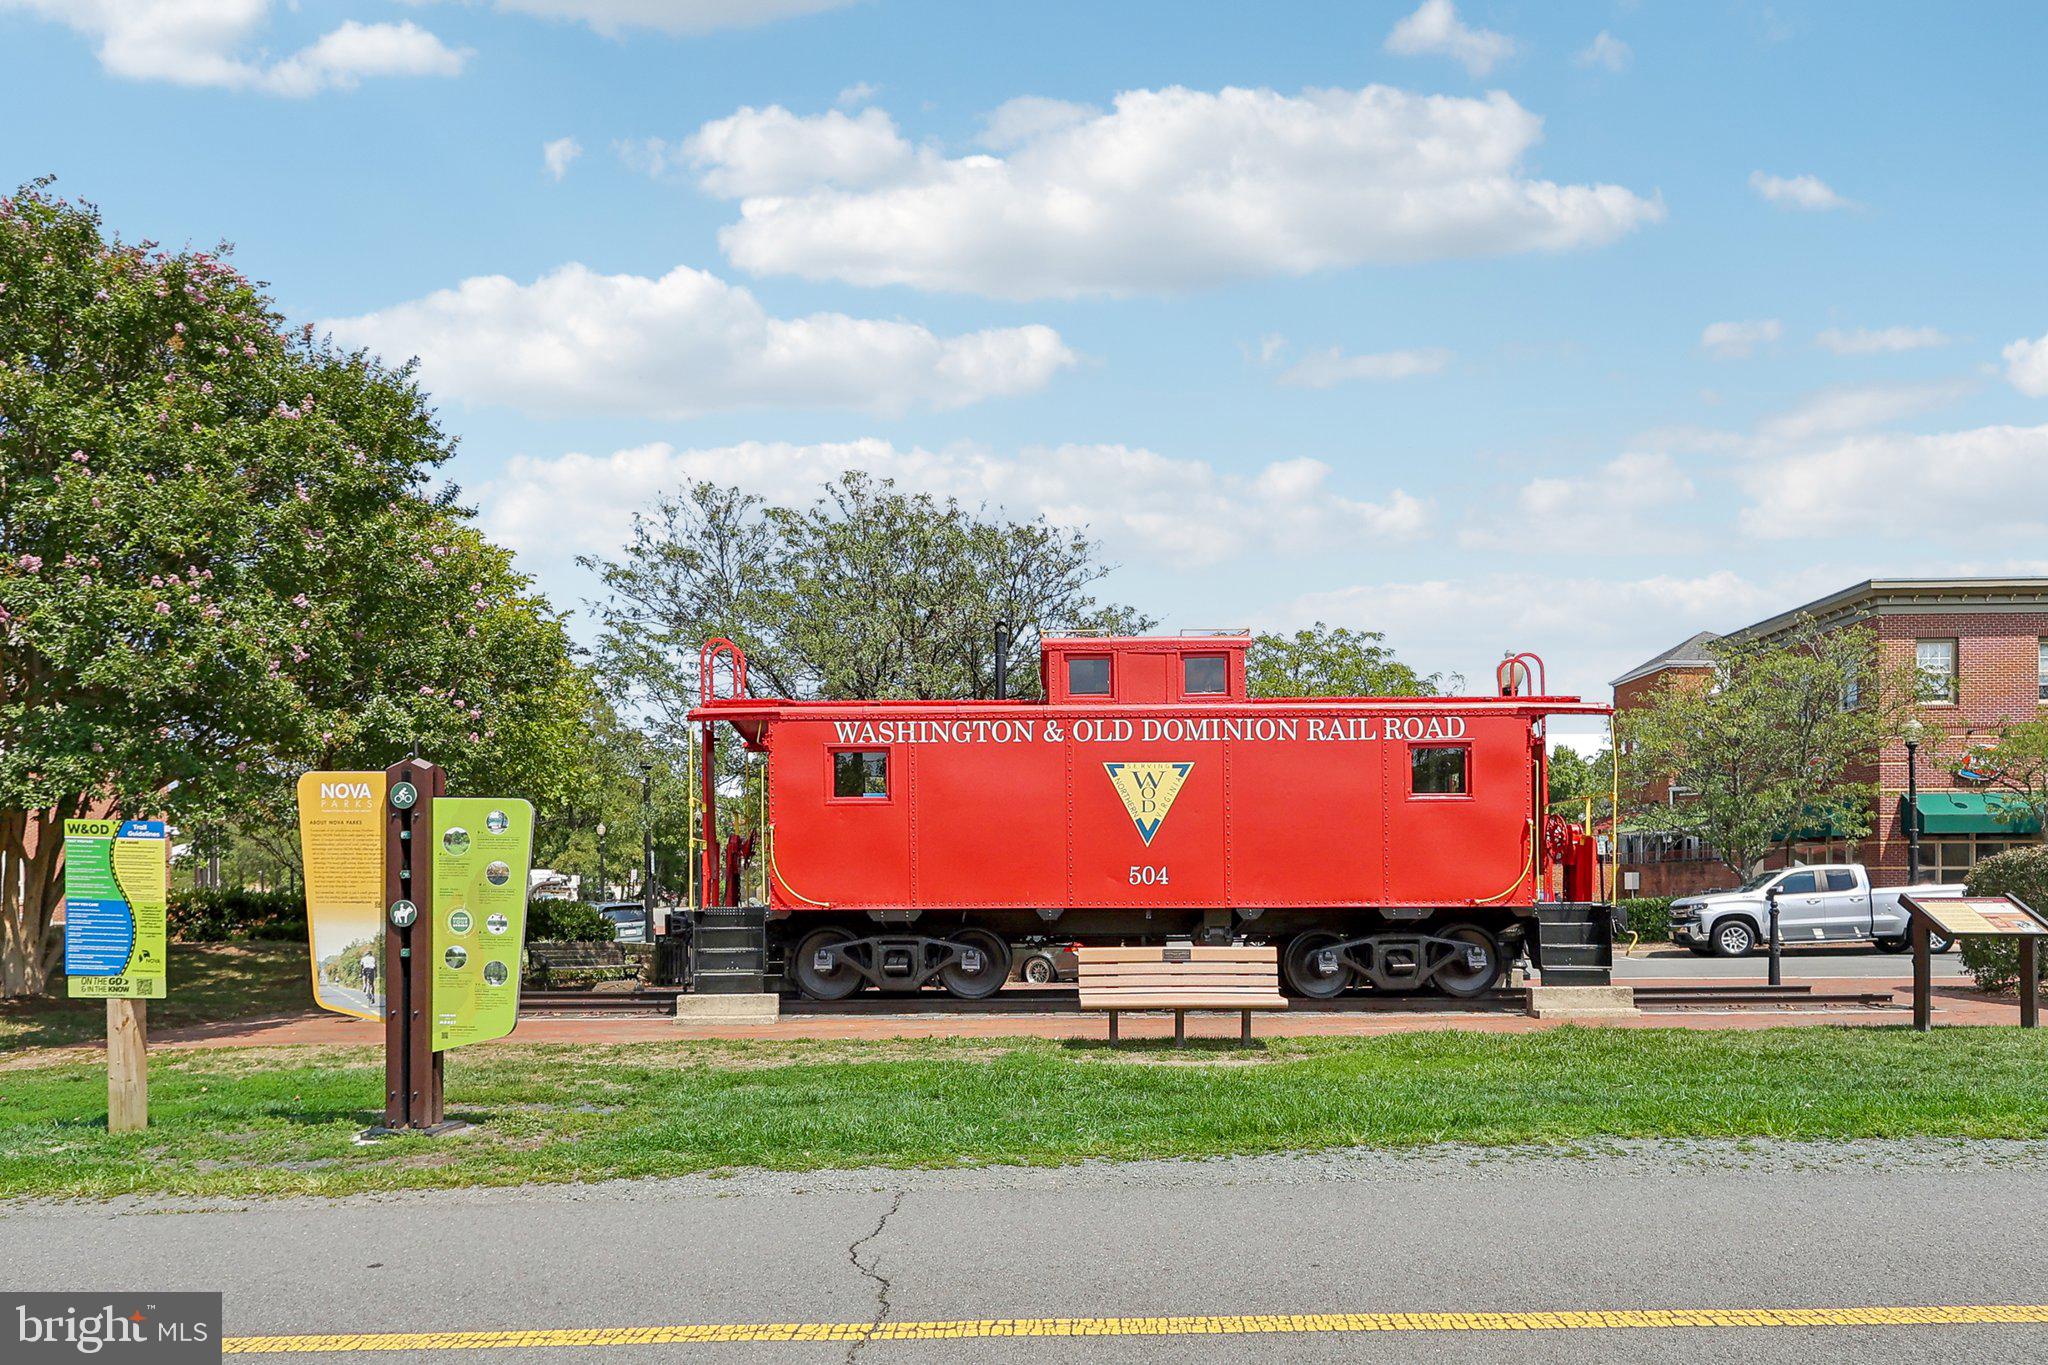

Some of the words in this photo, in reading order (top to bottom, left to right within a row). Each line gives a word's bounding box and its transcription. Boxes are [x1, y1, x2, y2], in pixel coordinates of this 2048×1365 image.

[833, 720, 1036, 744] WASHINGTON
[1042, 719, 1065, 743] &
[1072, 719, 1134, 743] OLD
[1141, 718, 1299, 742] DOMINION
[1306, 718, 1377, 741] RAIL
[1383, 716, 1467, 740] ROAD
[321, 783, 372, 799] NOVA
[1114, 777, 1139, 818] NORTHERN
[1155, 777, 1183, 818] VIRGINIA
[321, 800, 373, 809] PARKS
[67, 823, 110, 835] W&OD
[1128, 865, 1170, 886] 504
[81, 977, 92, 985] ON
[108, 977, 123, 985] GO
